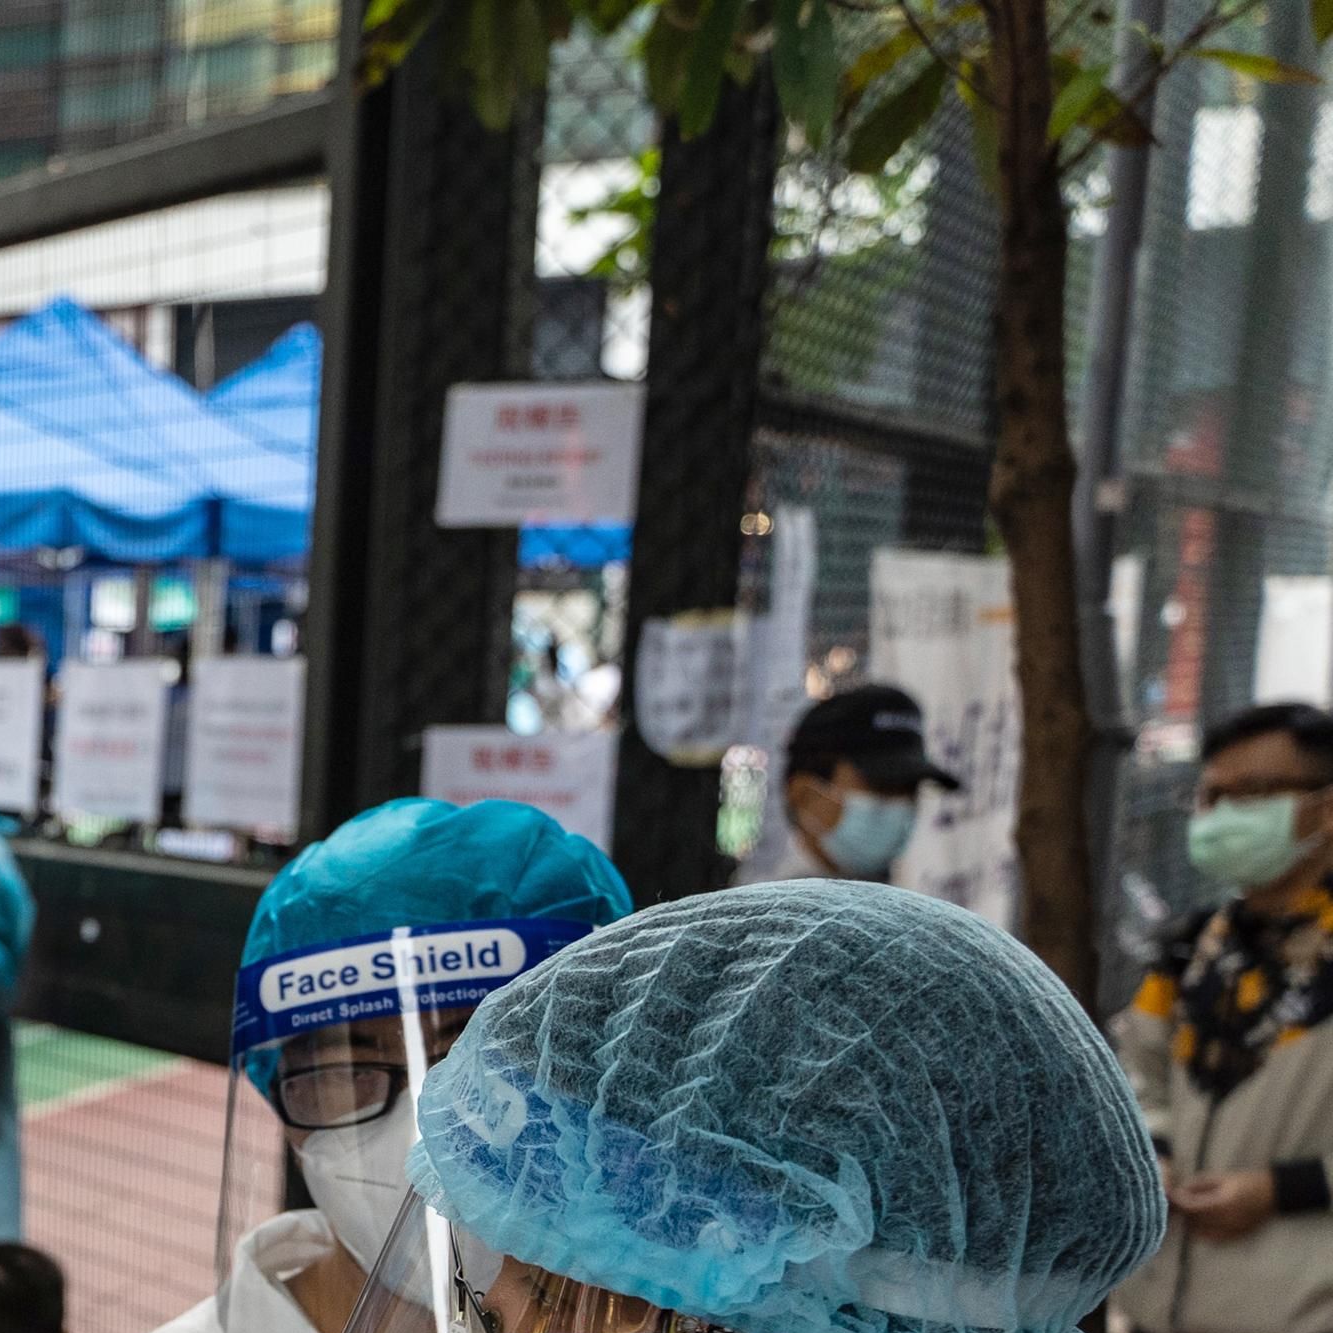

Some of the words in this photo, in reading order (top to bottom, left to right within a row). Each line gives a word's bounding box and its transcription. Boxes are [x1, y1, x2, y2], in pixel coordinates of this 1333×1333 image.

[278, 965, 359, 1001] Face
[372, 939, 502, 981] Shield
[291, 1007, 334, 1028] Direct
[339, 996, 394, 1019] Splash
[405, 987, 489, 1005] otection
